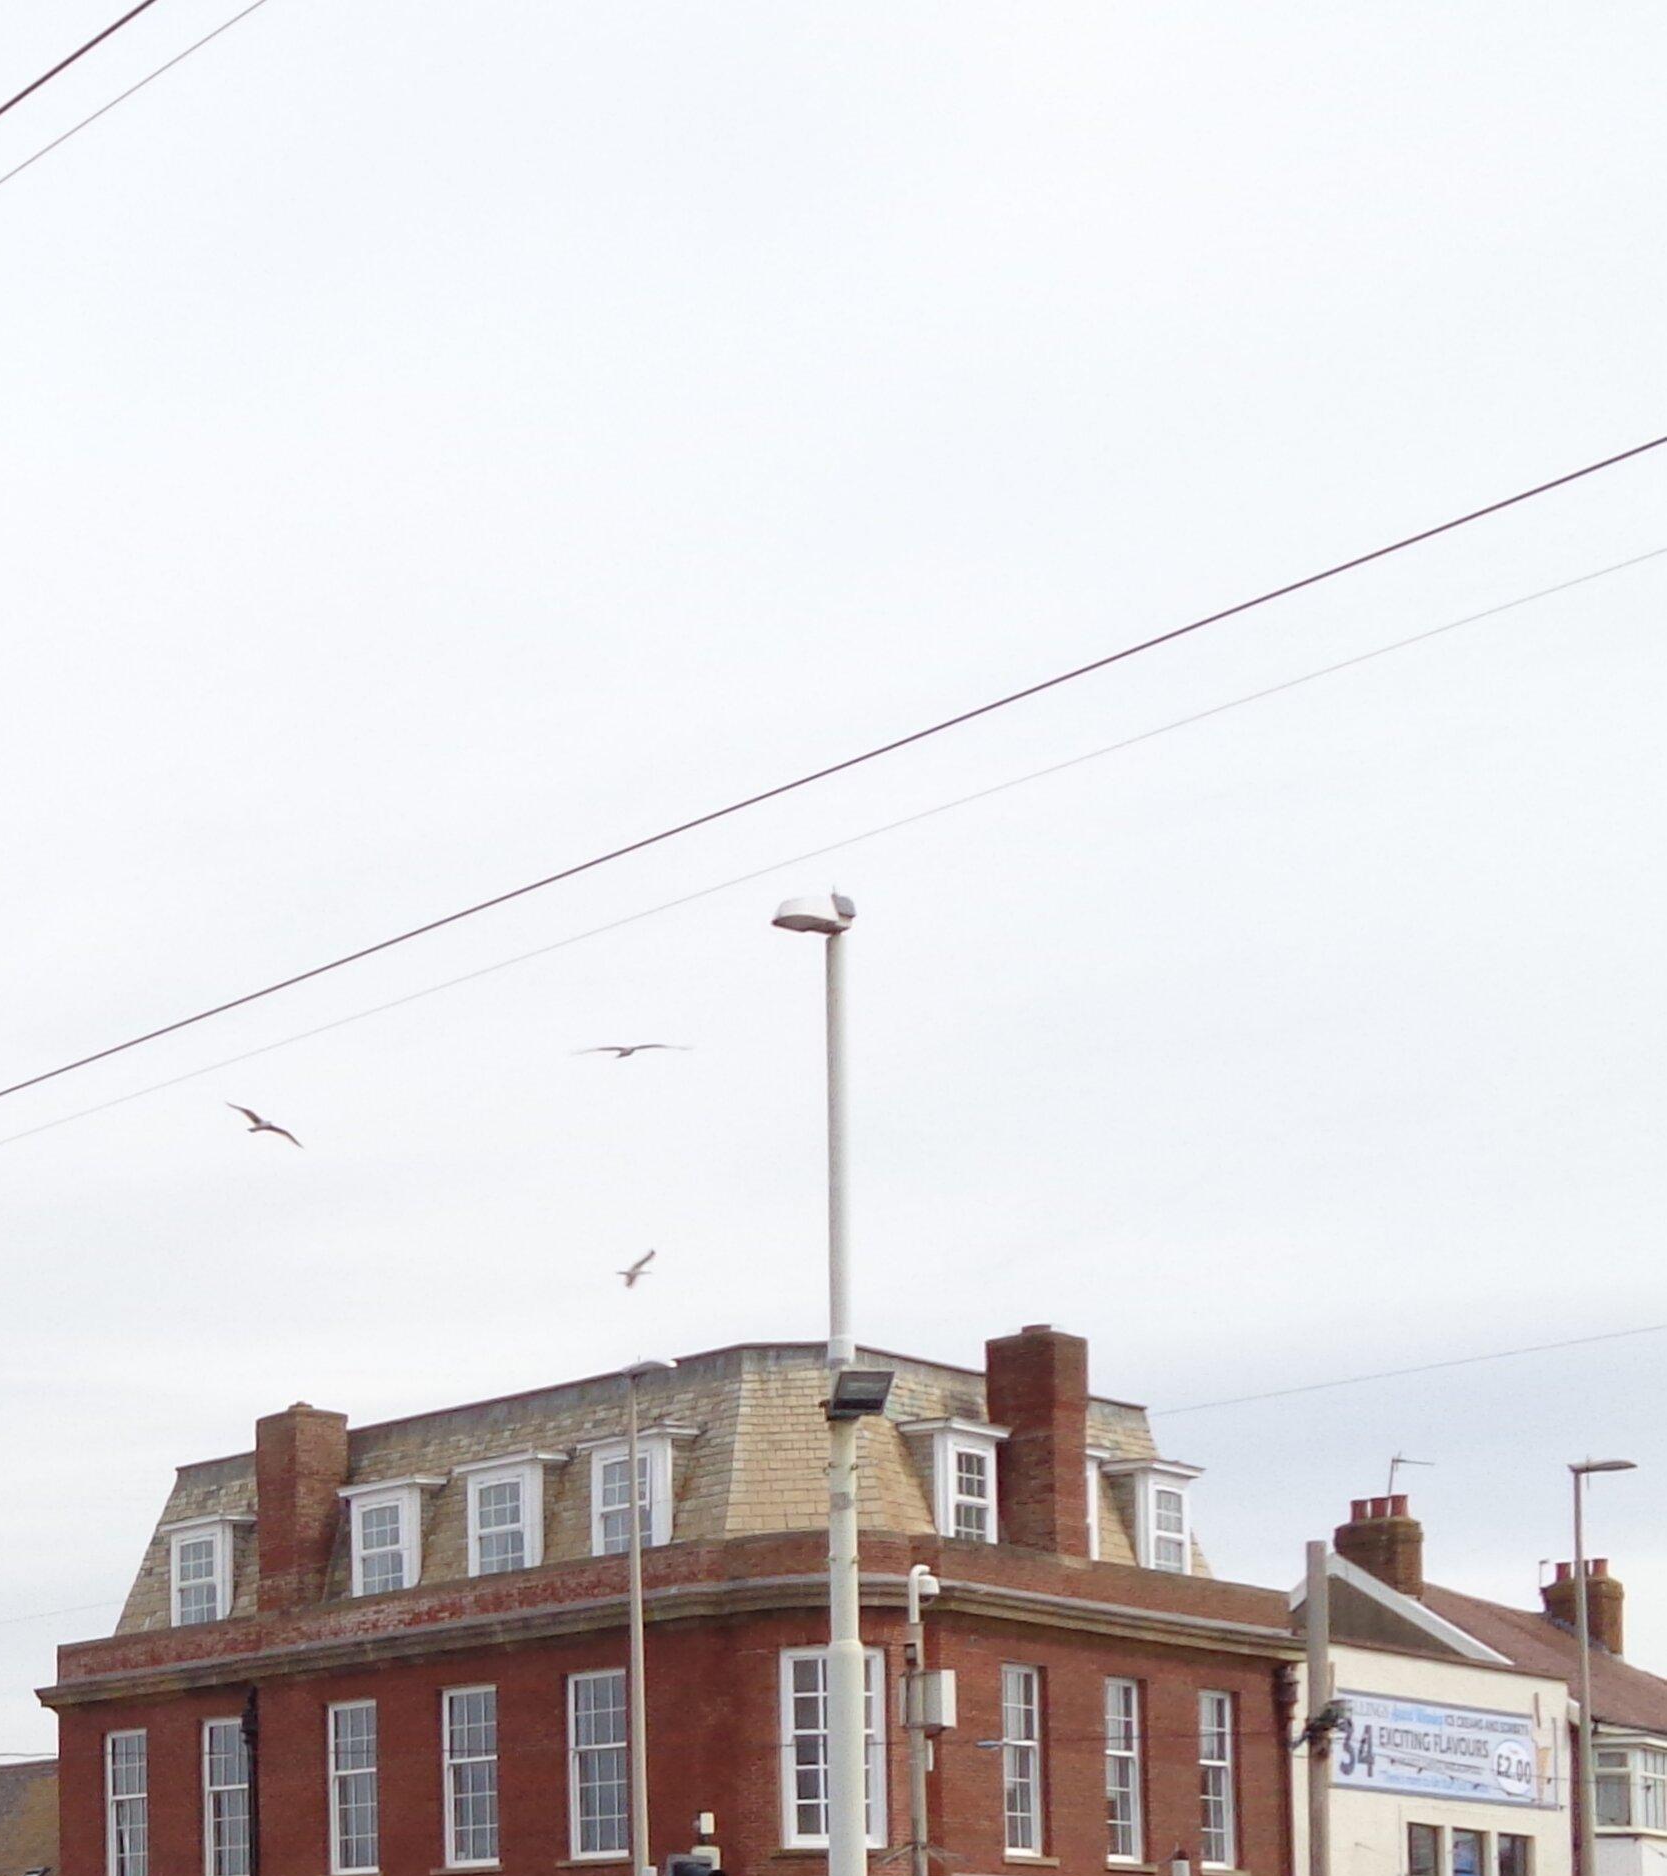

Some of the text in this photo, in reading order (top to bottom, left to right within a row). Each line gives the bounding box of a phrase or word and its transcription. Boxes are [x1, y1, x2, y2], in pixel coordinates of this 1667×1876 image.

[1338, 1718, 1375, 1778] 34
[1378, 1726, 1489, 1759] EXCITING FLAVOURS
[1496, 1753, 1532, 1785] £2.00
